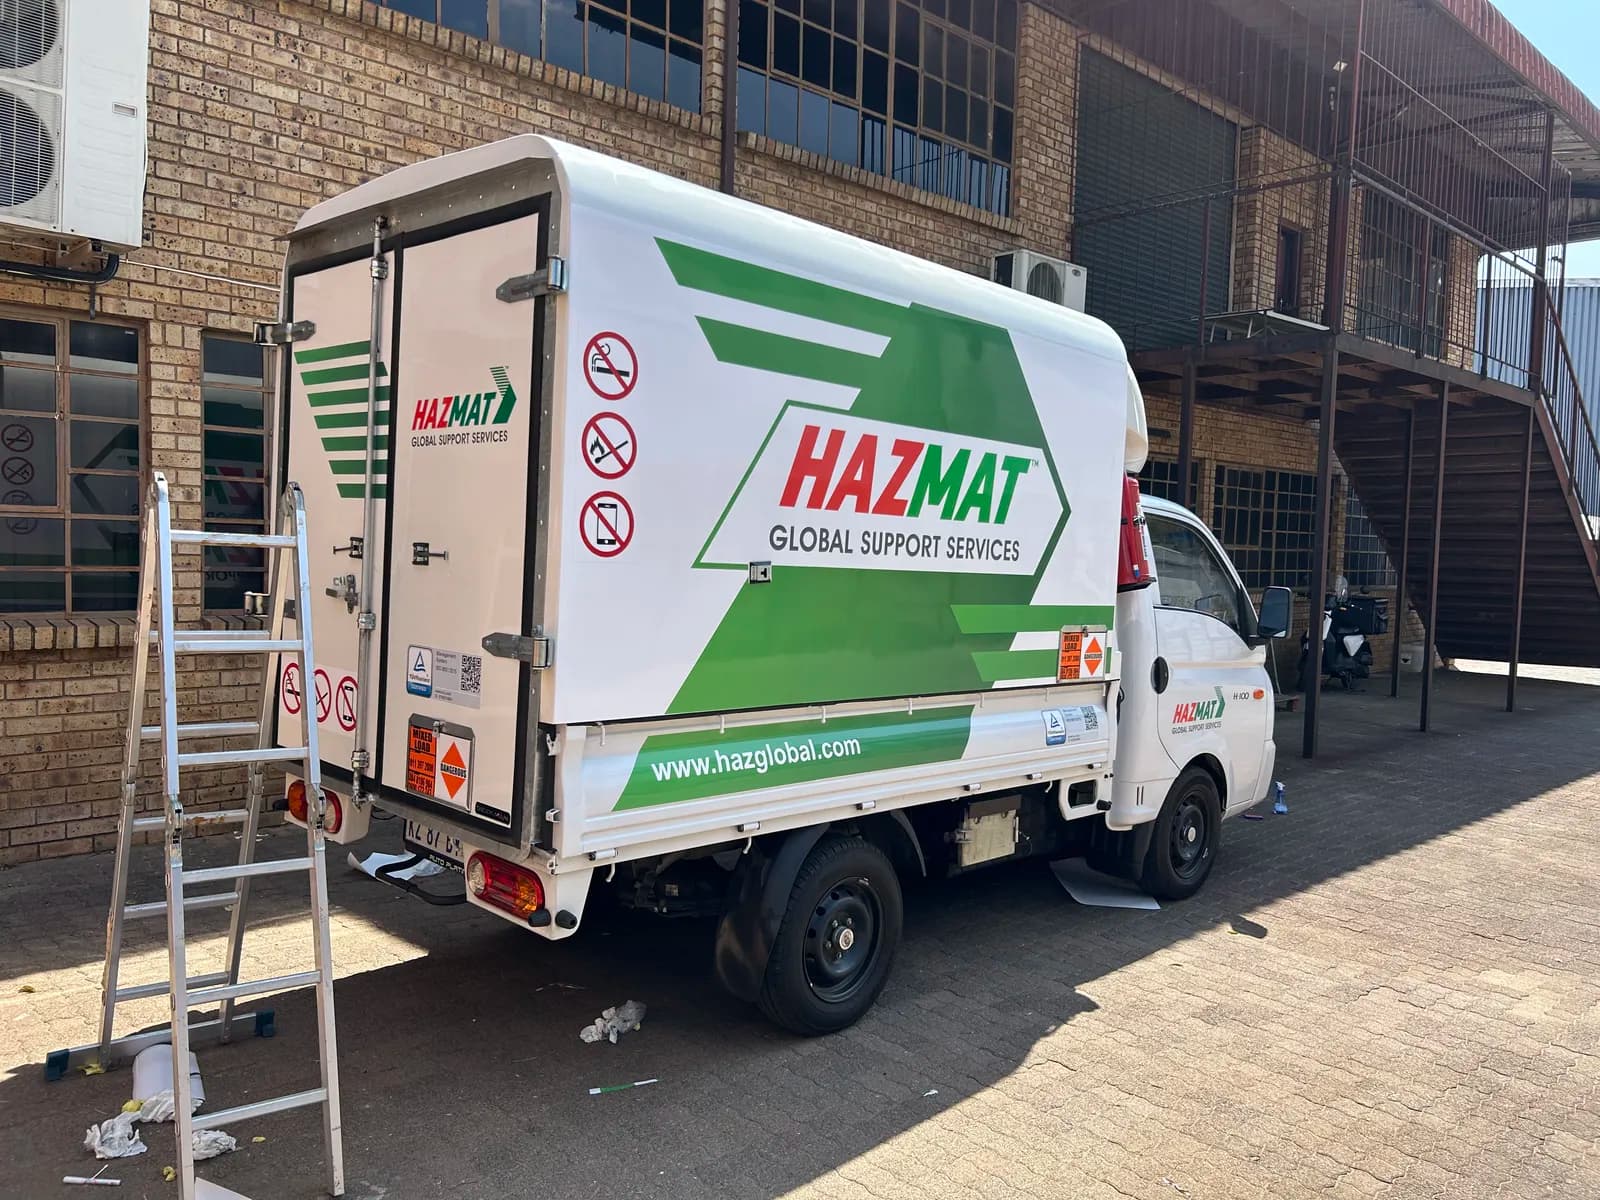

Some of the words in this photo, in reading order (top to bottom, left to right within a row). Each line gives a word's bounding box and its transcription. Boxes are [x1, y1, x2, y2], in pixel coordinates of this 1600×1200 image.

[411, 391, 497, 431] HAZMAT
[411, 435, 437, 447] GLOBAL
[438, 432, 470, 446] SUPPORT
[471, 430, 508, 444] SERVICES
[778, 424, 1032, 525] HAZMAT
[769, 524, 854, 554] GLOBAL
[860, 530, 941, 558] SUPPORT
[946, 535, 1020, 562] SERVICES
[1172, 699, 1218, 724] HAZMAT
[412, 728, 433, 743] MIXED
[1171, 726, 1188, 735] GLOBAL
[1188, 724, 1205, 733] SUPPORT
[1204, 721, 1222, 731] SERVICES
[414, 739, 431, 753] LOAD
[651, 738, 862, 781] www.hazglobal.com
[440, 762, 467, 779] DANGEROUS
[429, 854, 445, 866] AUTO
